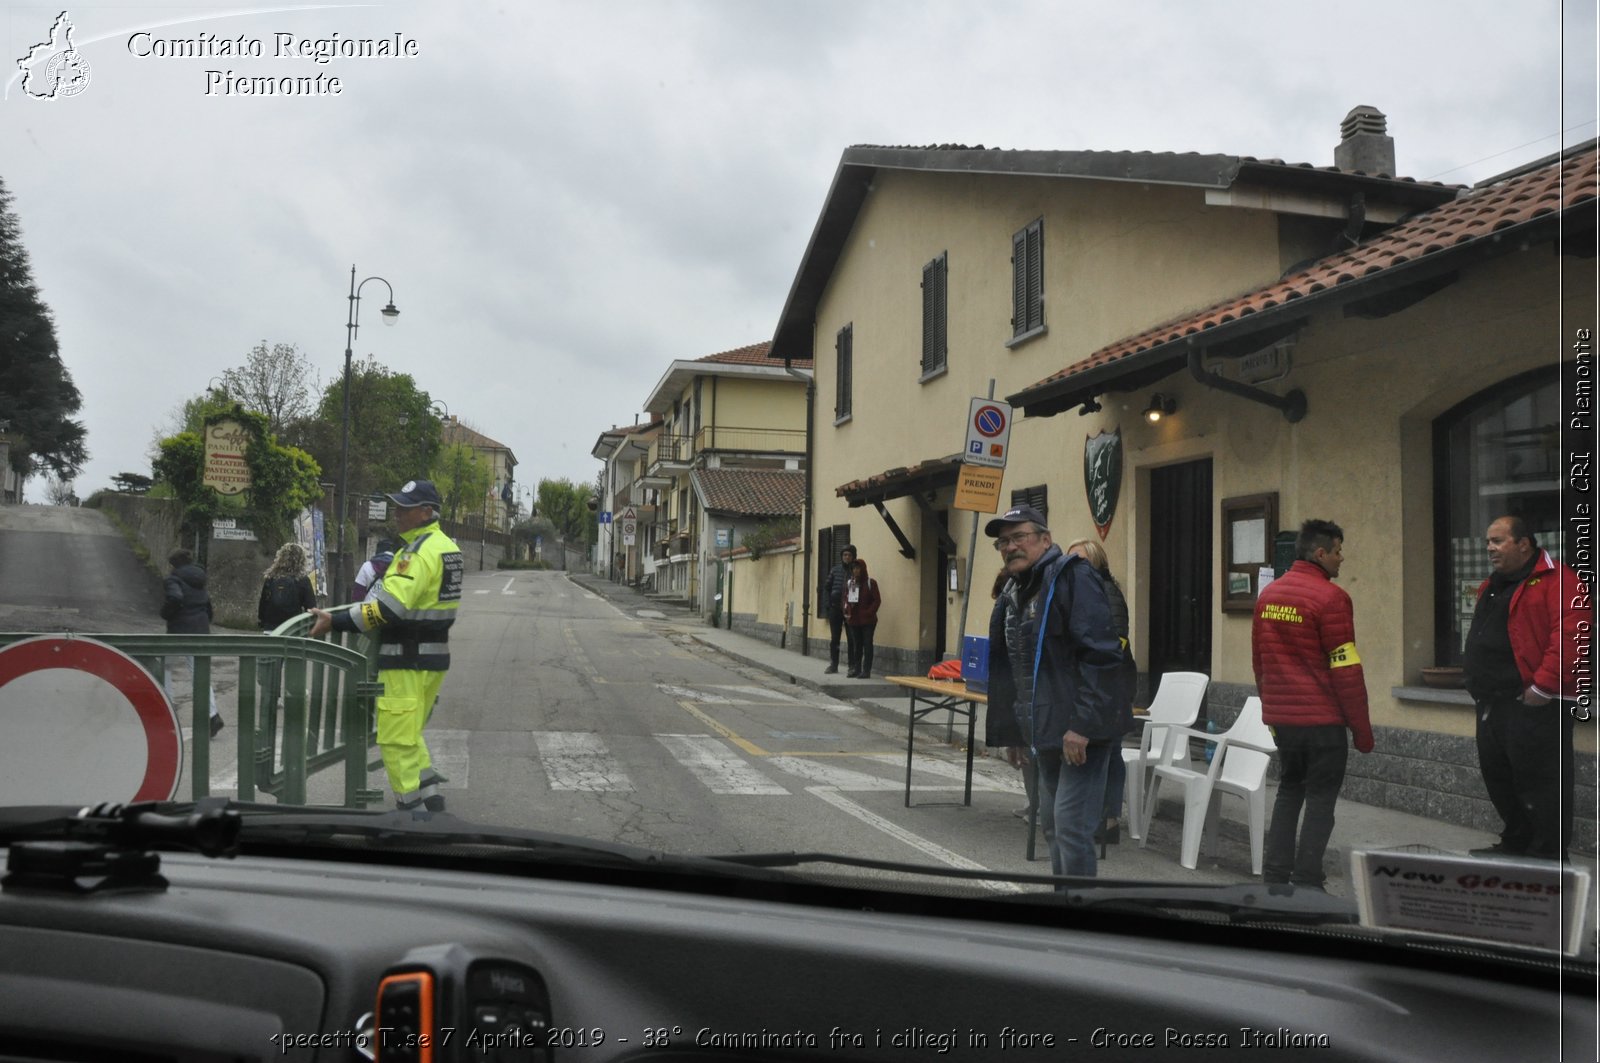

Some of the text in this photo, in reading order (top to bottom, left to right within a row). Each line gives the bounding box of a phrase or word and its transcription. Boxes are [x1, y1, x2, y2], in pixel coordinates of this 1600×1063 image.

[211, 426, 251, 446] Caff
[210, 459, 250, 468] GELATERI
[205, 467, 250, 476] PASTICCERI
[205, 475, 250, 483] CAFFETTERI
[964, 479, 995, 489] PRENDI
[1266, 604, 1297, 614] VIGILANZA
[1261, 611, 1303, 623] ANTINCENDIO
[1374, 865, 1561, 896] New Glass
